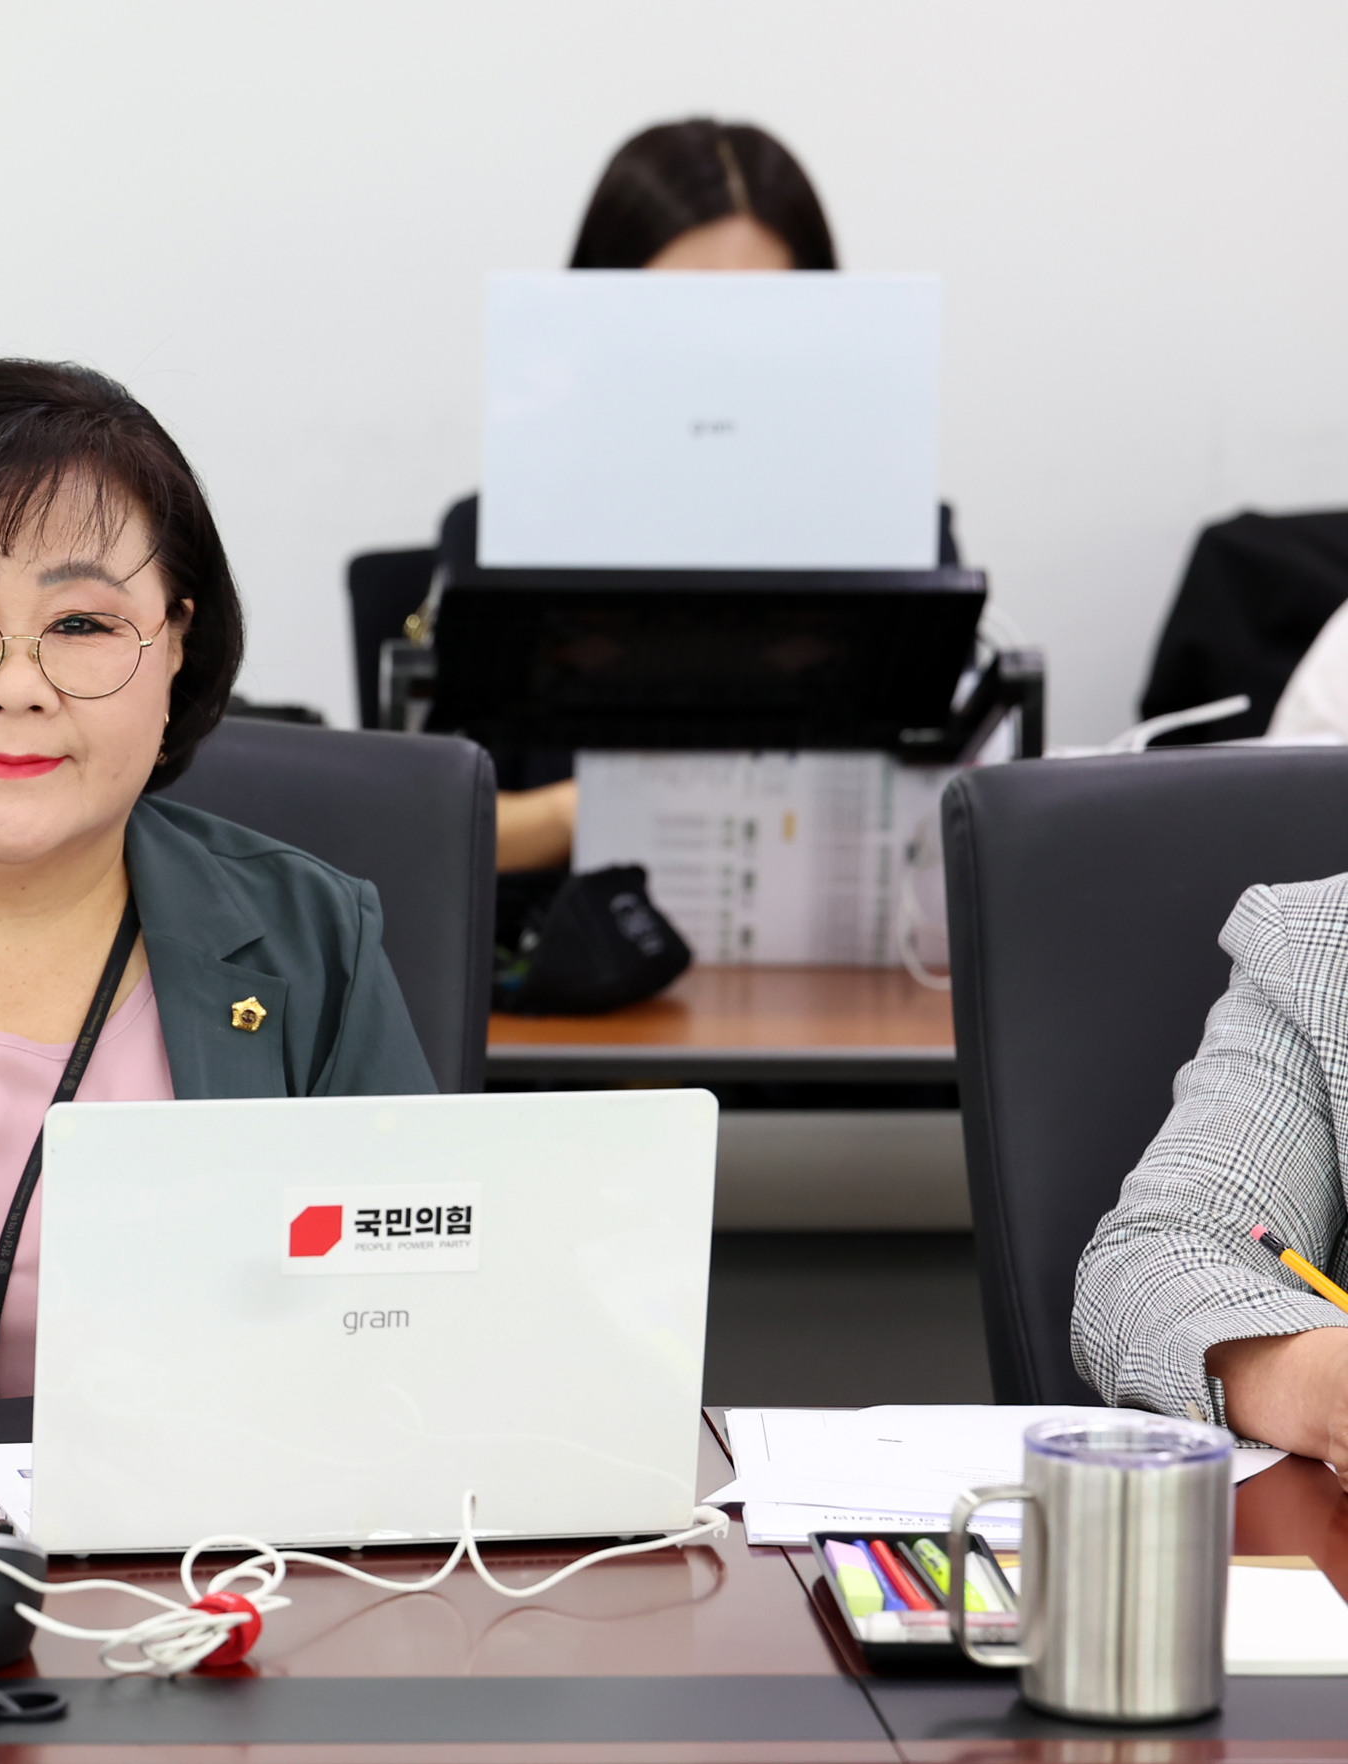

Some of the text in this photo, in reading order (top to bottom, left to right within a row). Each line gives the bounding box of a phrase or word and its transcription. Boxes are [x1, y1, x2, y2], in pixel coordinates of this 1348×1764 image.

[0, 1211, 21, 1257] 성남시의회
[354, 1206, 472, 1237] 국민의힘
[355, 1240, 471, 1252] PEOPLE POWER PARTY
[342, 1310, 410, 1335] gram
